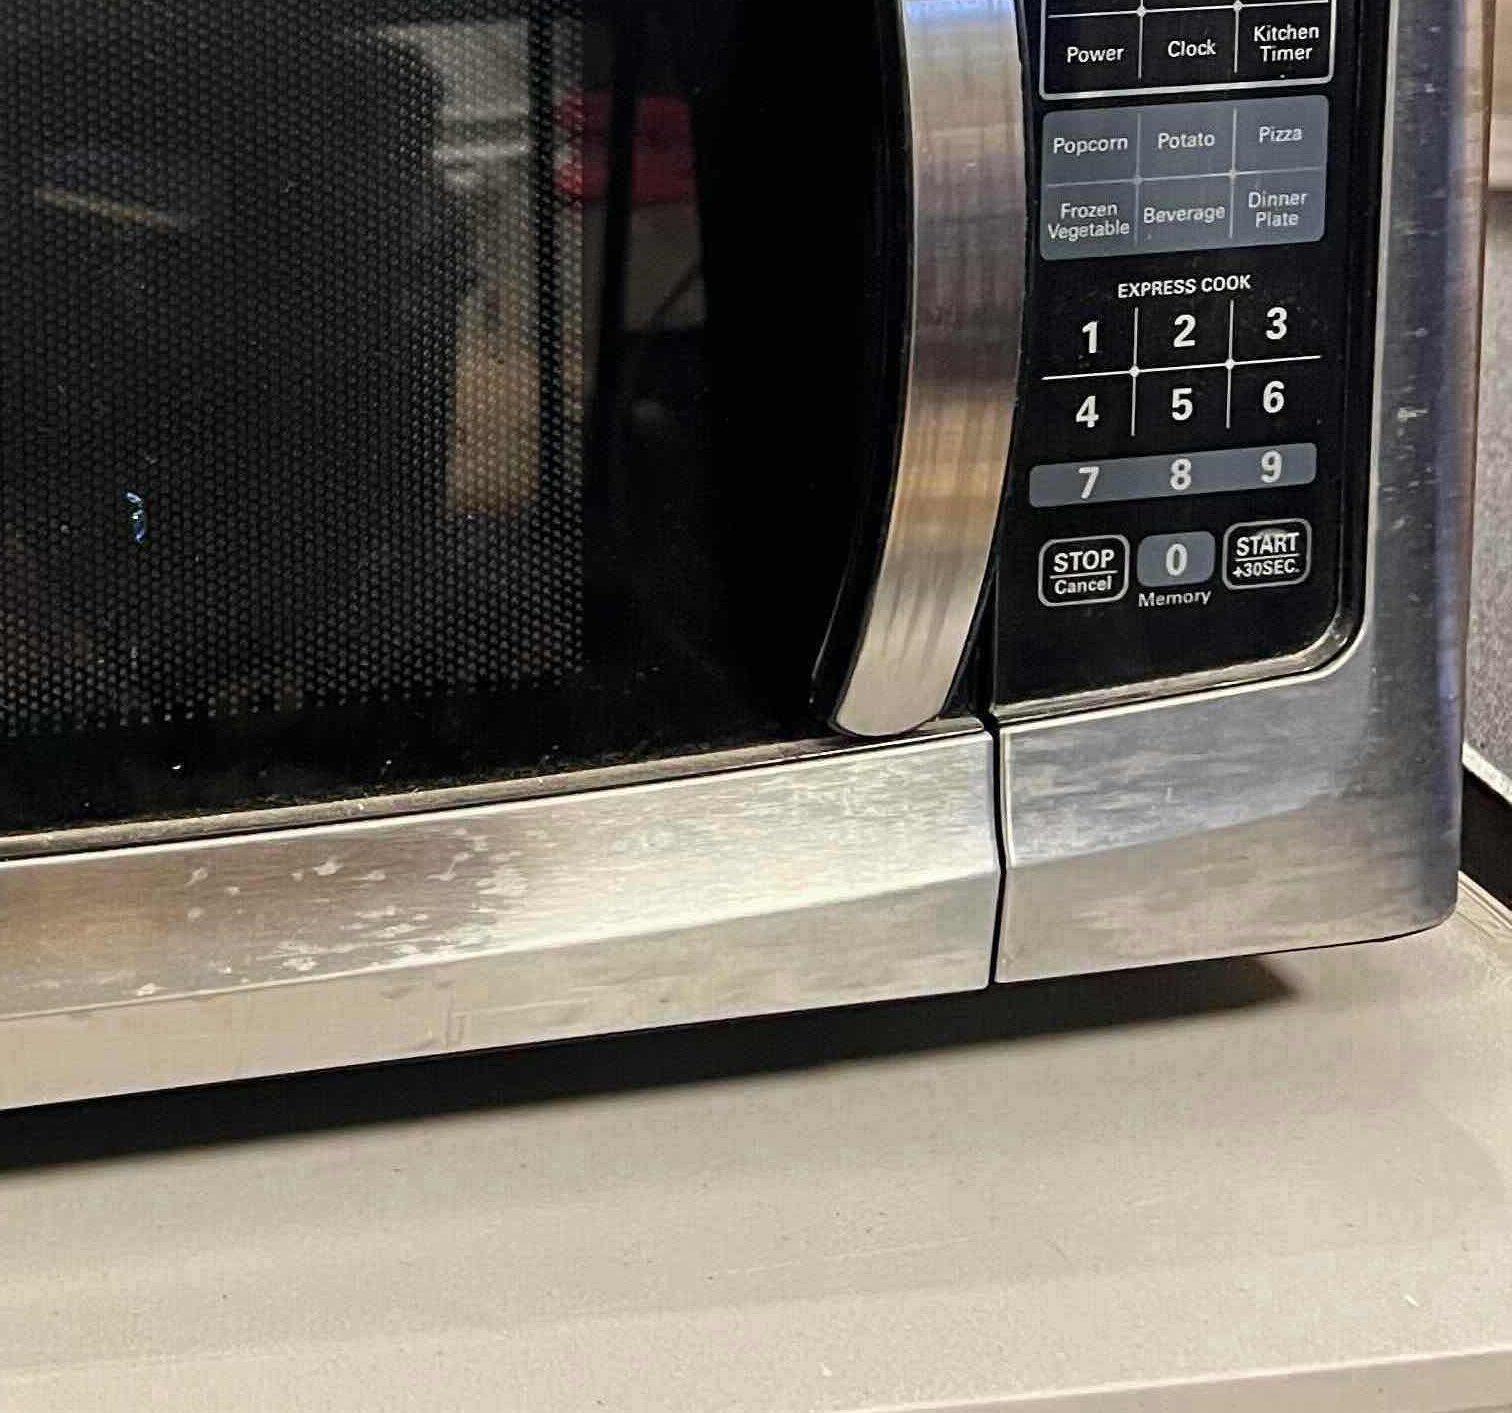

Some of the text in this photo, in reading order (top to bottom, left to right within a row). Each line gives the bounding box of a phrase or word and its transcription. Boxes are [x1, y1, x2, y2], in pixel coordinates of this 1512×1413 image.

[1254, 25, 1319, 43] Kitchen
[1067, 47, 1123, 63] Power
[1168, 40, 1216, 58] Clock
[1260, 45, 1312, 62] Timer
[1053, 135, 1128, 154] Popcorn
[1158, 132, 1216, 149] Potato
[1259, 126, 1303, 142] Pizza
[1248, 190, 1308, 208] Dinner
[1061, 202, 1118, 219] Frozen
[1144, 204, 1225, 225] Beverage
[1255, 210, 1299, 227] Plate
[1048, 220, 1130, 241] Vegetable
[1118, 274, 1251, 298] EXPRESS COOK
[1174, 315, 1196, 347] 2
[1266, 308, 1287, 340] 3
[1082, 322, 1099, 353] 1
[1172, 388, 1193, 420] 5
[1263, 381, 1284, 413] 6
[1076, 395, 1099, 428] 4
[1170, 459, 1192, 490] 8
[1261, 451, 1282, 482] 9
[1079, 467, 1100, 499] 7
[1236, 532, 1300, 556] START
[1054, 551, 1114, 573] STOP
[1166, 544, 1188, 576] 0
[1055, 577, 1112, 595] Cancel
[1138, 589, 1211, 608] Memory
